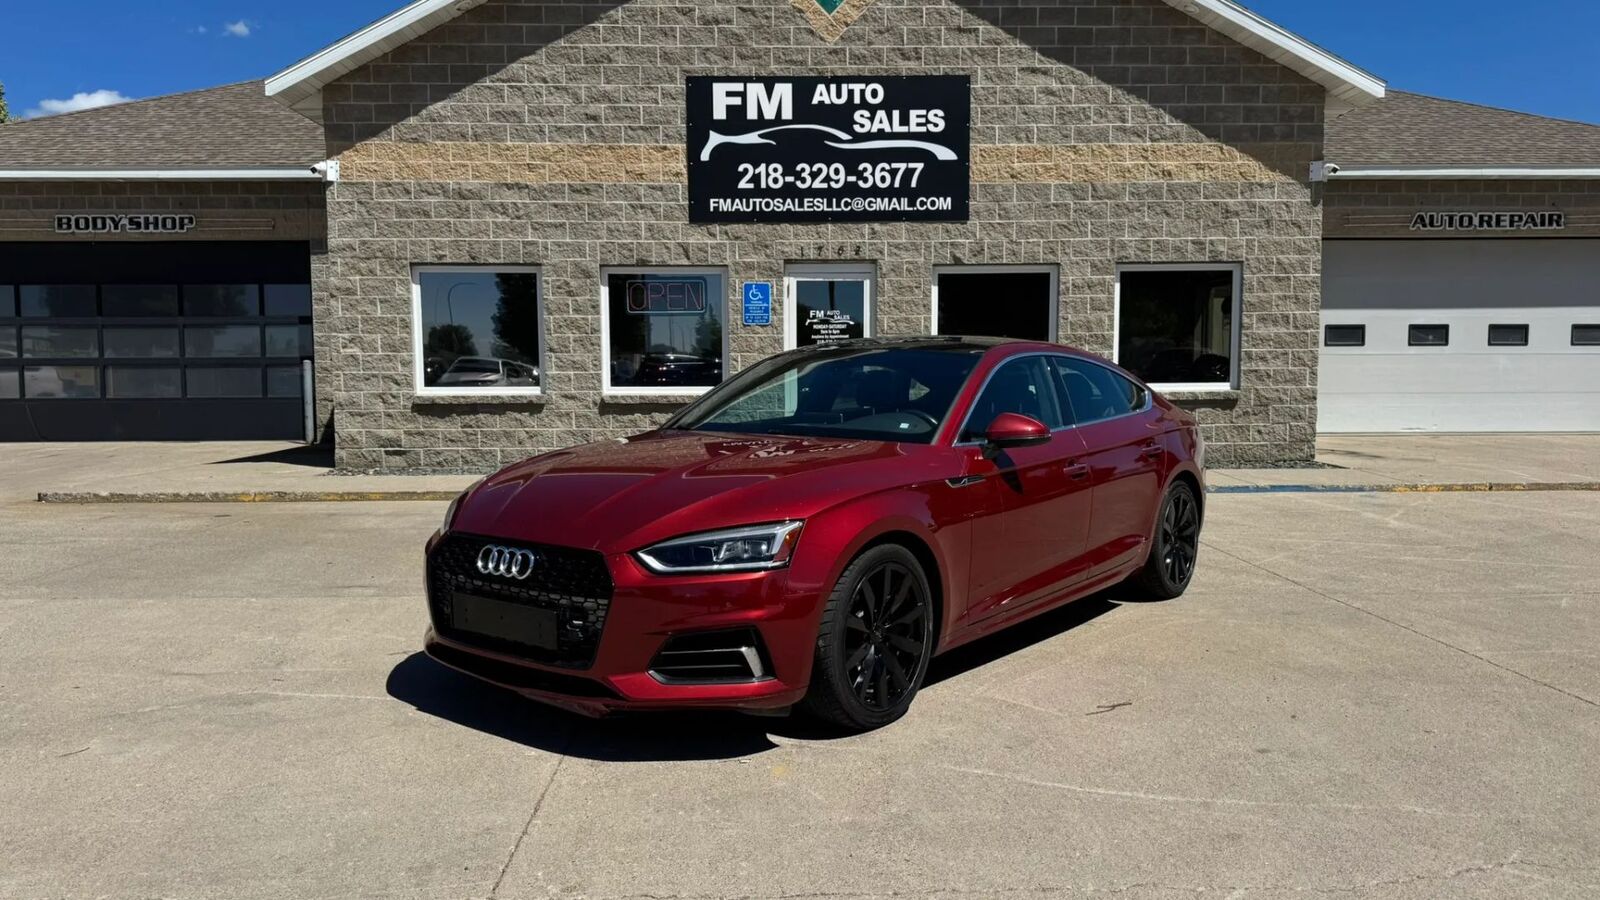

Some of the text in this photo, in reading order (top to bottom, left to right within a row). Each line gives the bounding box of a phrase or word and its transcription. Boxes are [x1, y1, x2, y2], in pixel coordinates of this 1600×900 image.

[712, 82, 884, 120] FM AUTO
[853, 109, 946, 133] SALES
[737, 163, 925, 189] 218-329-3677
[709, 197, 952, 212] FMAUTOSALESLLC@GMAIL.COM
[55, 215, 195, 232] BODY SHOP
[1410, 212, 1565, 230] AUTO REPAIR
[630, 283, 702, 310] OPEN
[809, 310, 825, 318] FM
